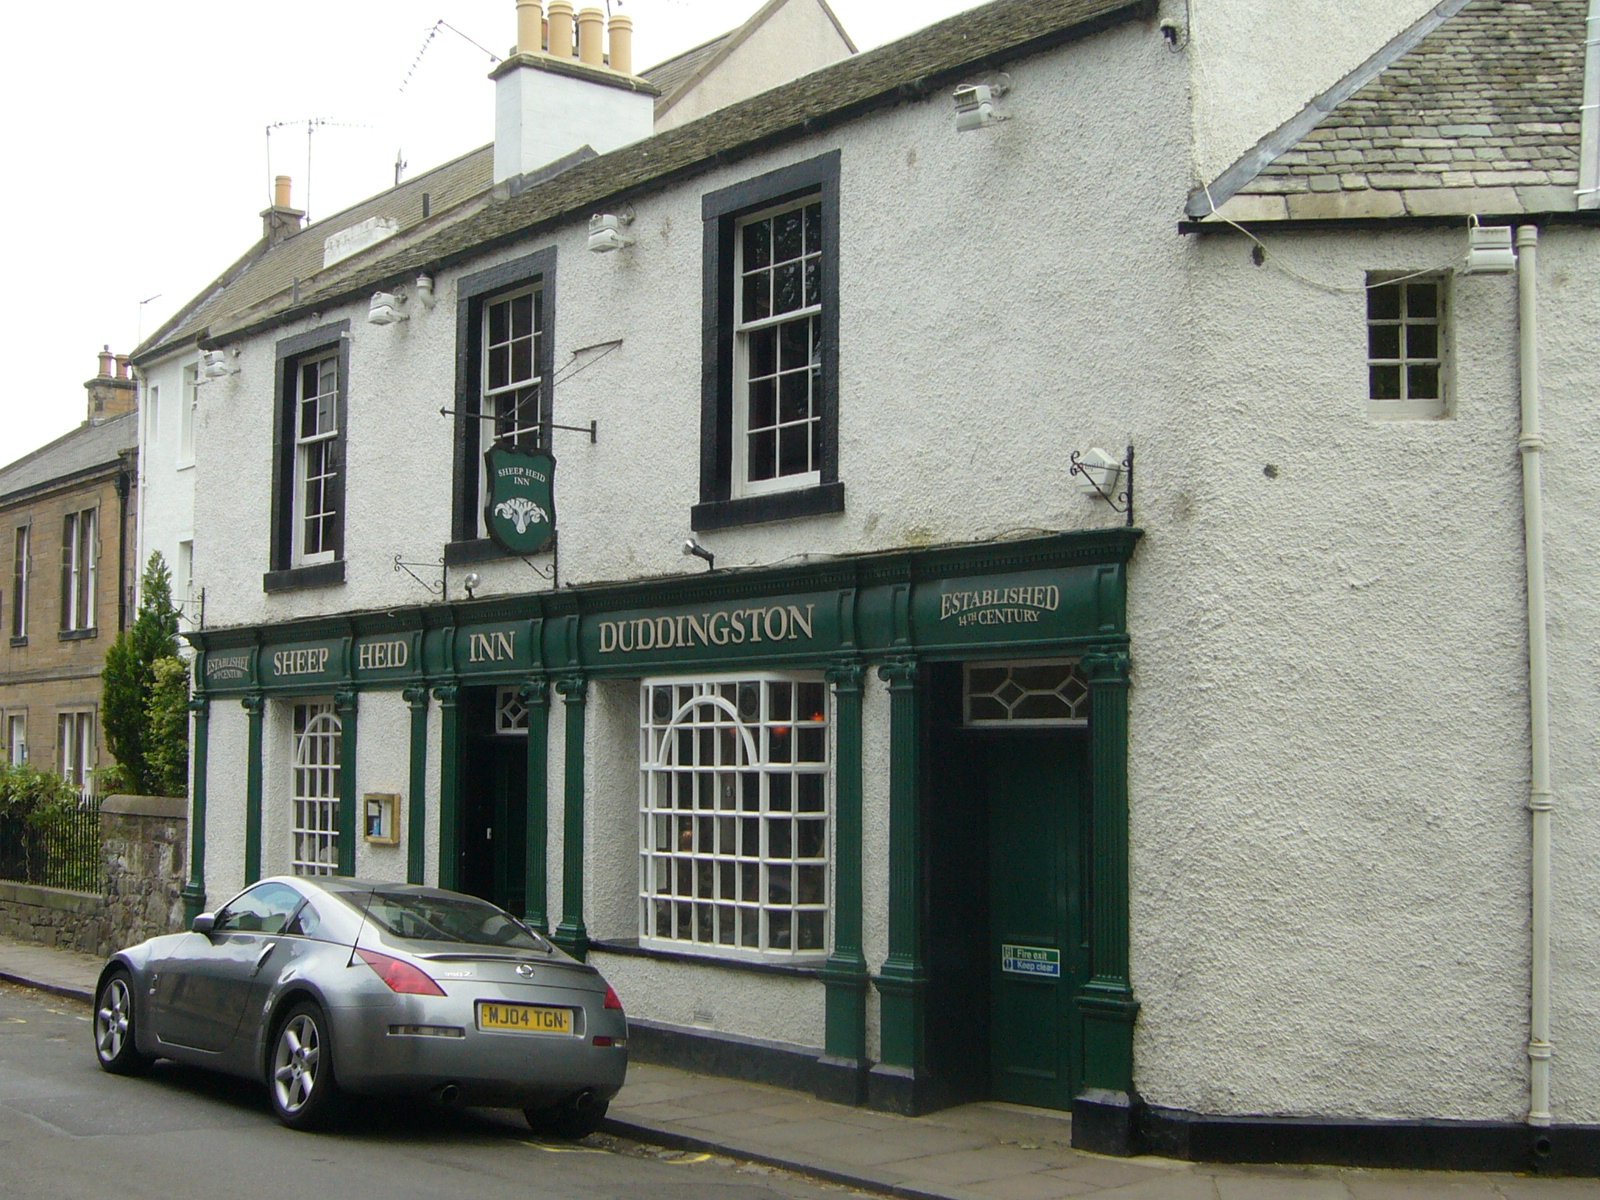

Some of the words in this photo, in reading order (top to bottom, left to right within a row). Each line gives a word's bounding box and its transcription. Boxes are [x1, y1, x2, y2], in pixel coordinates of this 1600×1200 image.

[498, 467, 524, 476] SHEEP
[525, 469, 546, 483] HEID
[514, 476, 530, 486] INN
[940, 585, 1060, 621] ESTABLISHED
[978, 608, 1040, 625] CENTURY
[273, 648, 329, 676] SHEEP
[358, 641, 408, 670] HEID
[469, 631, 515, 662] INN
[598, 604, 815, 653] DUDDINGSTON
[1017, 949, 1032, 960] Fire
[1033, 951, 1047, 960] exit
[1017, 961, 1035, 971] Keep
[1036, 963, 1054, 973] clear
[489, 1006, 529, 1026] MJ04
[534, 1010, 563, 1029] TGN
